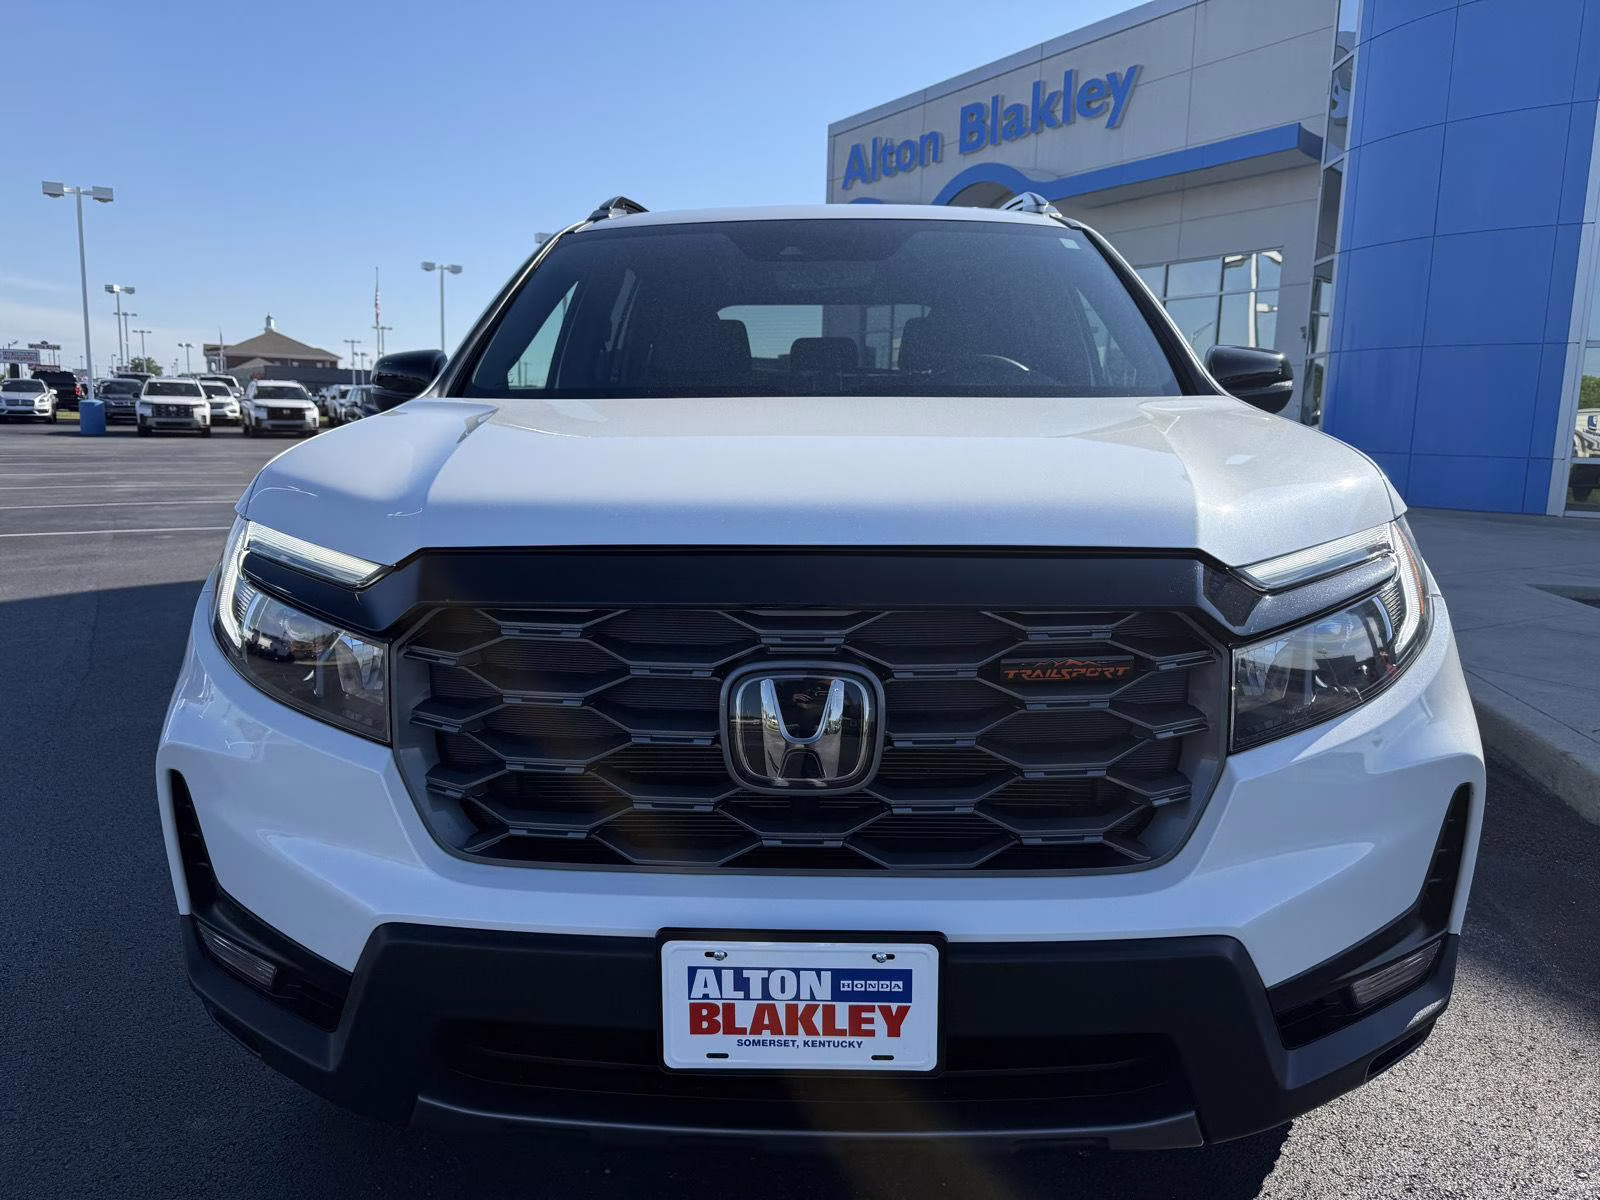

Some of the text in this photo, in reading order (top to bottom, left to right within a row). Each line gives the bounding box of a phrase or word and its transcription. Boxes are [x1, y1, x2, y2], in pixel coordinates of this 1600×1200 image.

[842, 64, 1144, 190] Alton Blakley
[1004, 666, 1130, 681] TRAILSPORT
[690, 968, 903, 1000] ALTON HONDA
[689, 1002, 911, 1038] BLAKLEY
[736, 1038, 863, 1049] SOMERSET, KENTUCKY
